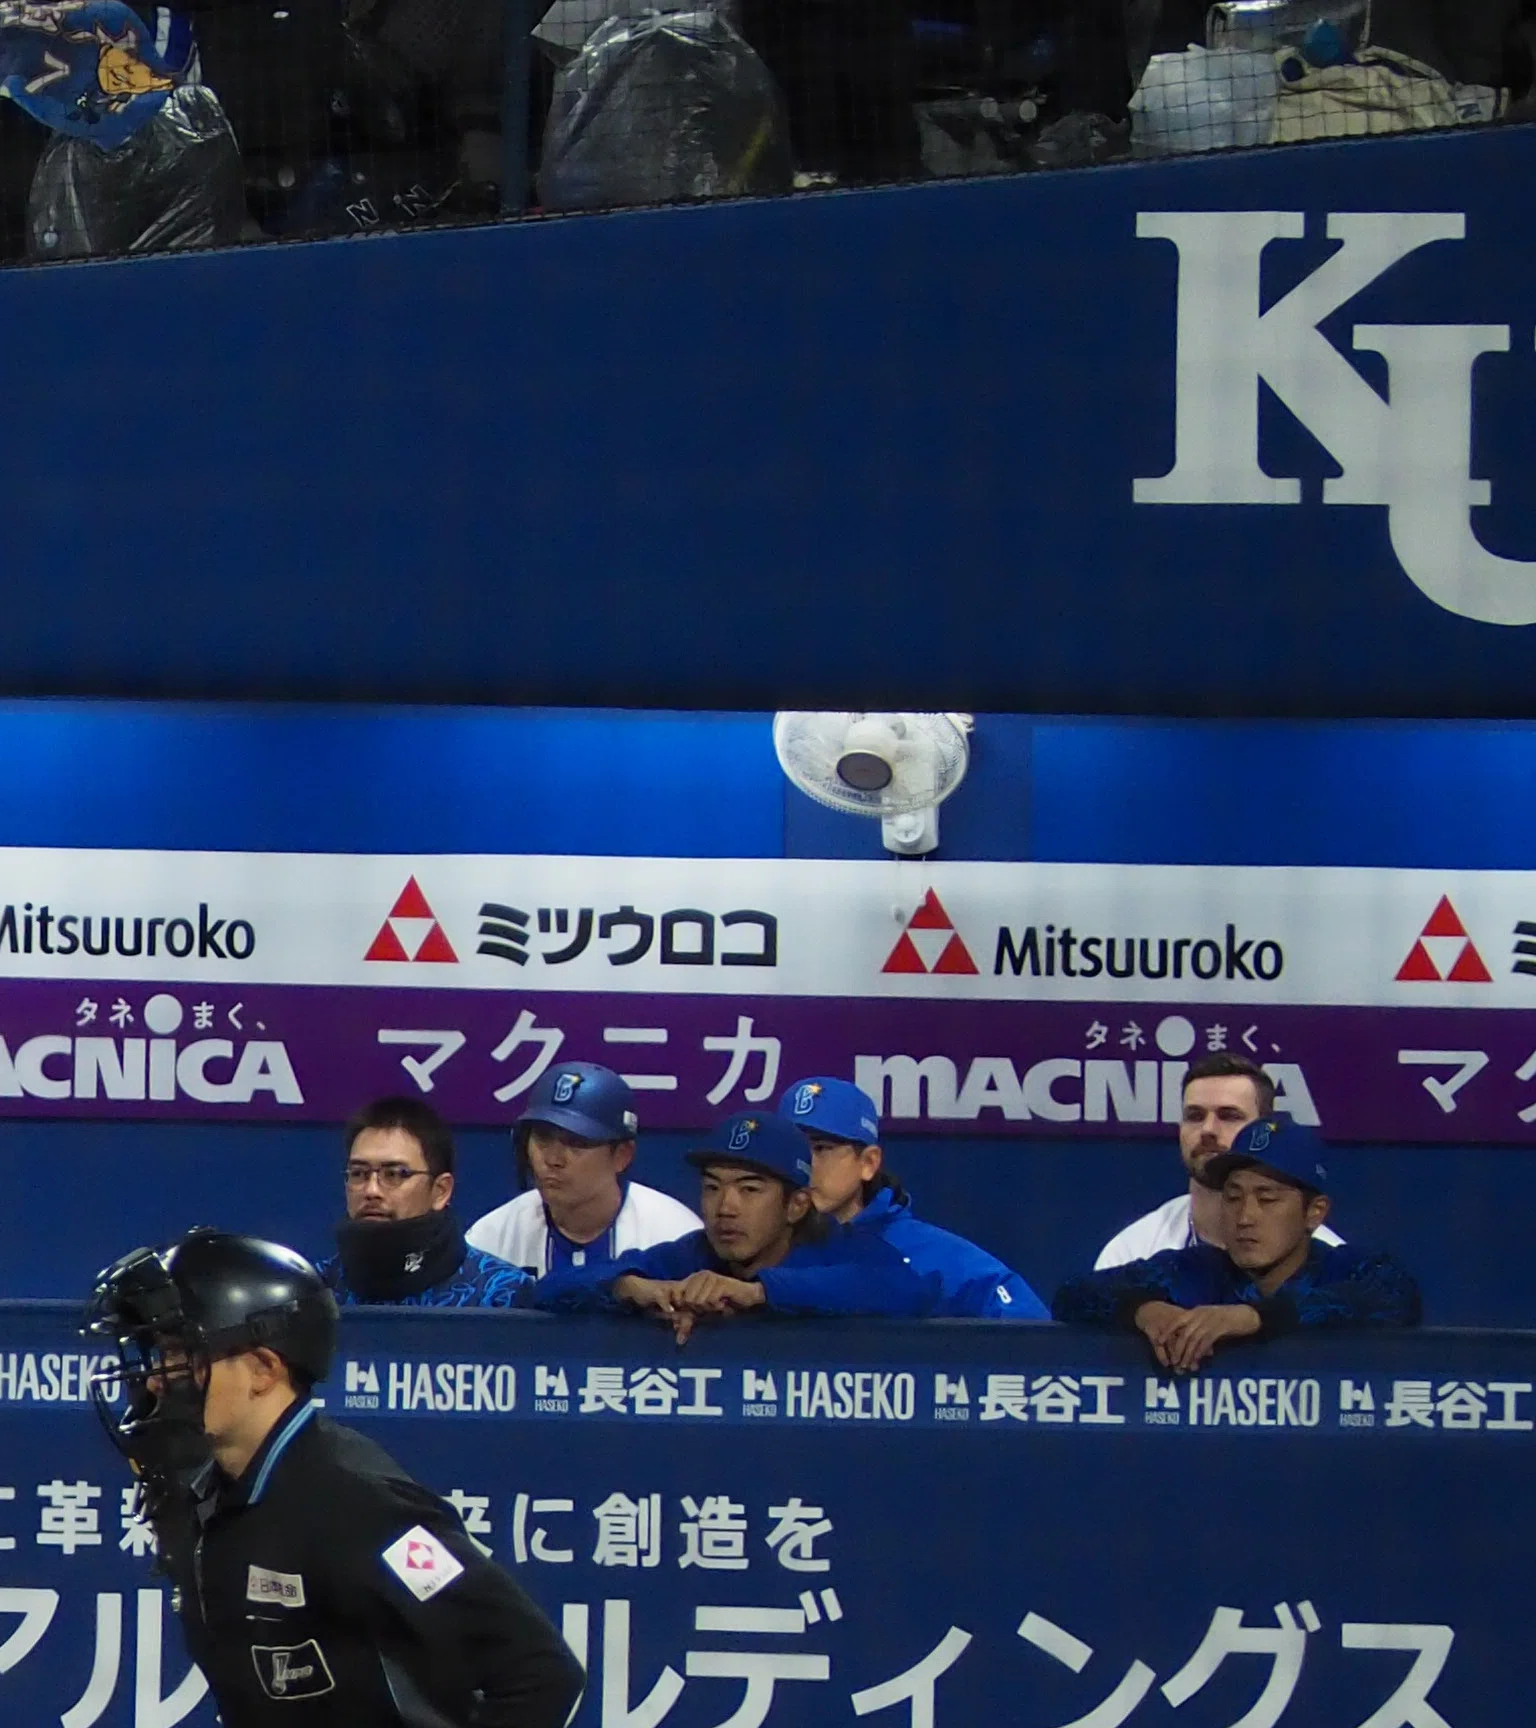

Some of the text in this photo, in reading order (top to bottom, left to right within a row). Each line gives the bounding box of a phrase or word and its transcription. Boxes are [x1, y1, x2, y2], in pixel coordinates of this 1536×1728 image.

[476, 903, 777, 967] ミツウロコ
[994, 924, 1283, 981] Mitsuuroko
[378, 1010, 781, 1104] マクニカ
[388, 1363, 515, 1411] HASEKO
[578, 1367, 722, 1416] 長谷工
[787, 1371, 914, 1420] HASEKO
[979, 1374, 1125, 1424] 長谷工
[1190, 1379, 1320, 1426] HASEKO
[1384, 1380, 1533, 1430] 長谷工
